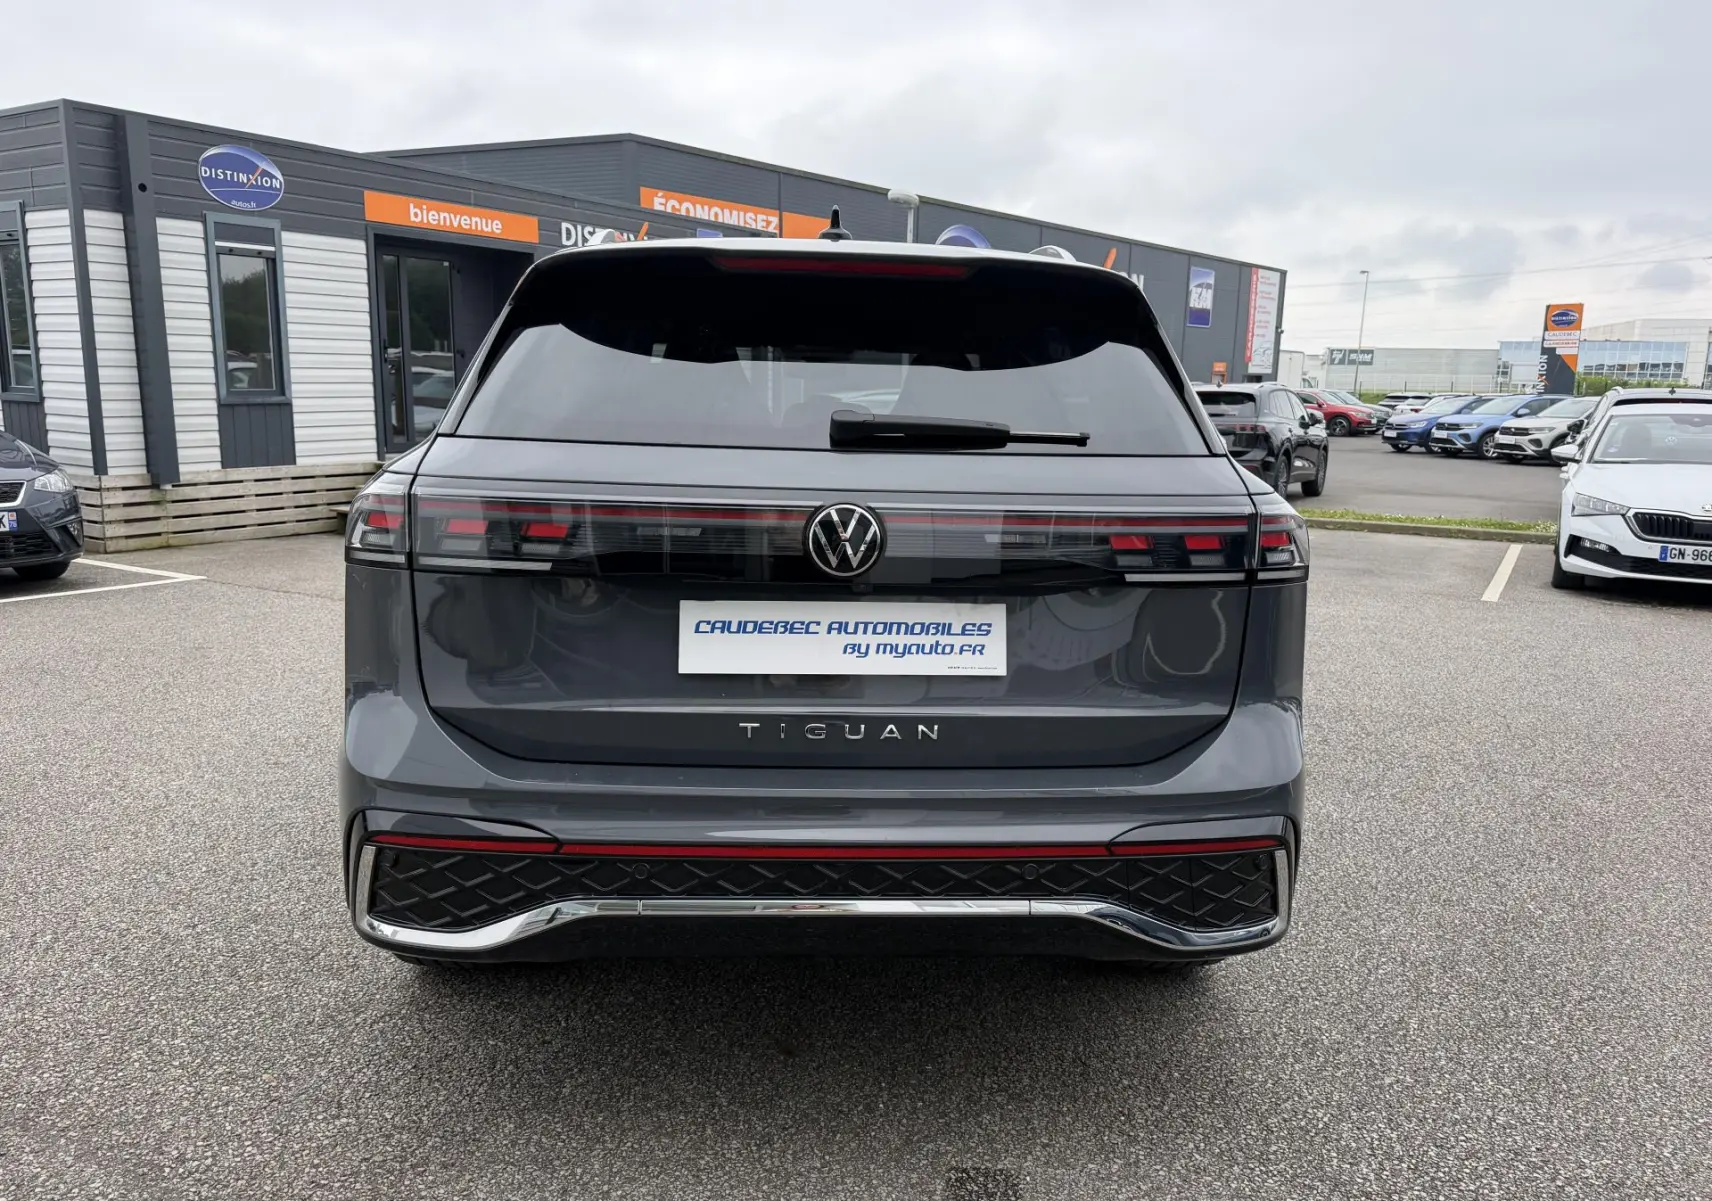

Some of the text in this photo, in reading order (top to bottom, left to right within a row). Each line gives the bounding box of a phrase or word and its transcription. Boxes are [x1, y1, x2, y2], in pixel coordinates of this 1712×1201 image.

[201, 166, 280, 189] DISTINXION
[409, 203, 503, 234] bienvenue
[694, 620, 992, 636] CAUDEBEC AUTOMOBILES
[738, 722, 939, 740] TIGUAN
